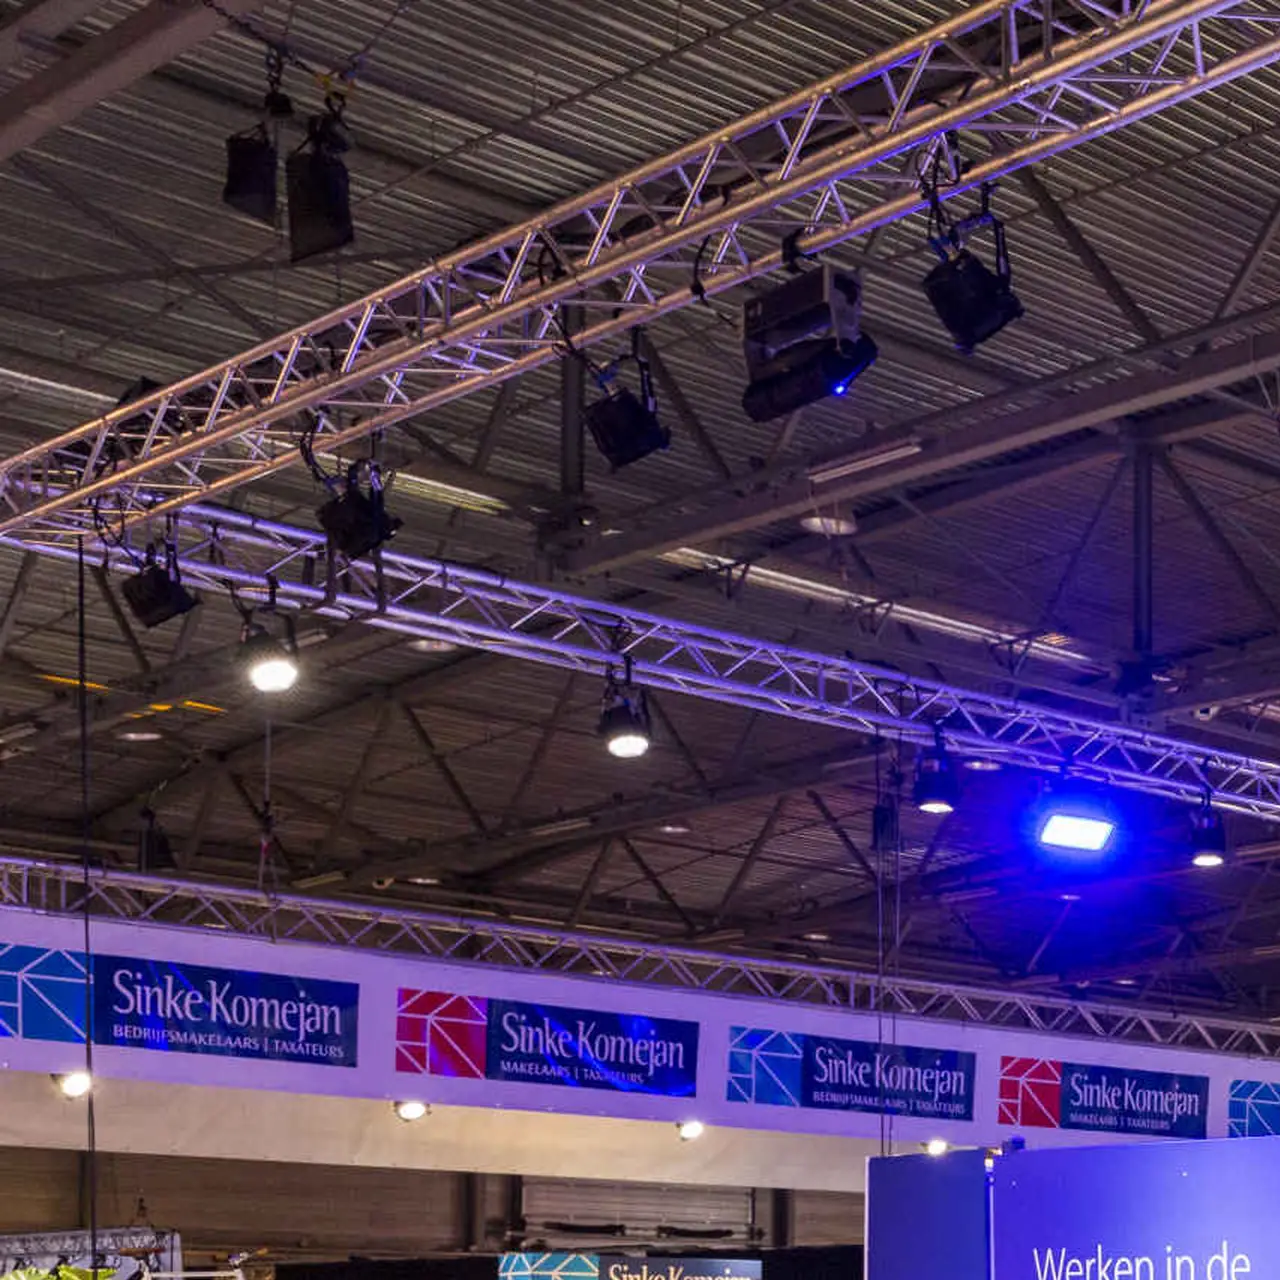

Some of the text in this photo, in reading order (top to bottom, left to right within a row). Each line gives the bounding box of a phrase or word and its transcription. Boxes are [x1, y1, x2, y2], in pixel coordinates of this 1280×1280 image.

[112, 969, 341, 1040] Sinke Komejan
[112, 1024, 260, 1050] BEDRIJFSMAKELAARS
[274, 1039, 344, 1058] TAXATEURS
[500, 1011, 685, 1076] Sinke Komejan
[500, 1060, 570, 1078] MAKELAARS
[813, 1046, 965, 1101] Sinke Komejan
[812, 1091, 908, 1110] BEDRIJFSMAKEAARS
[1070, 1073, 1199, 1122] Sinke Komejan
